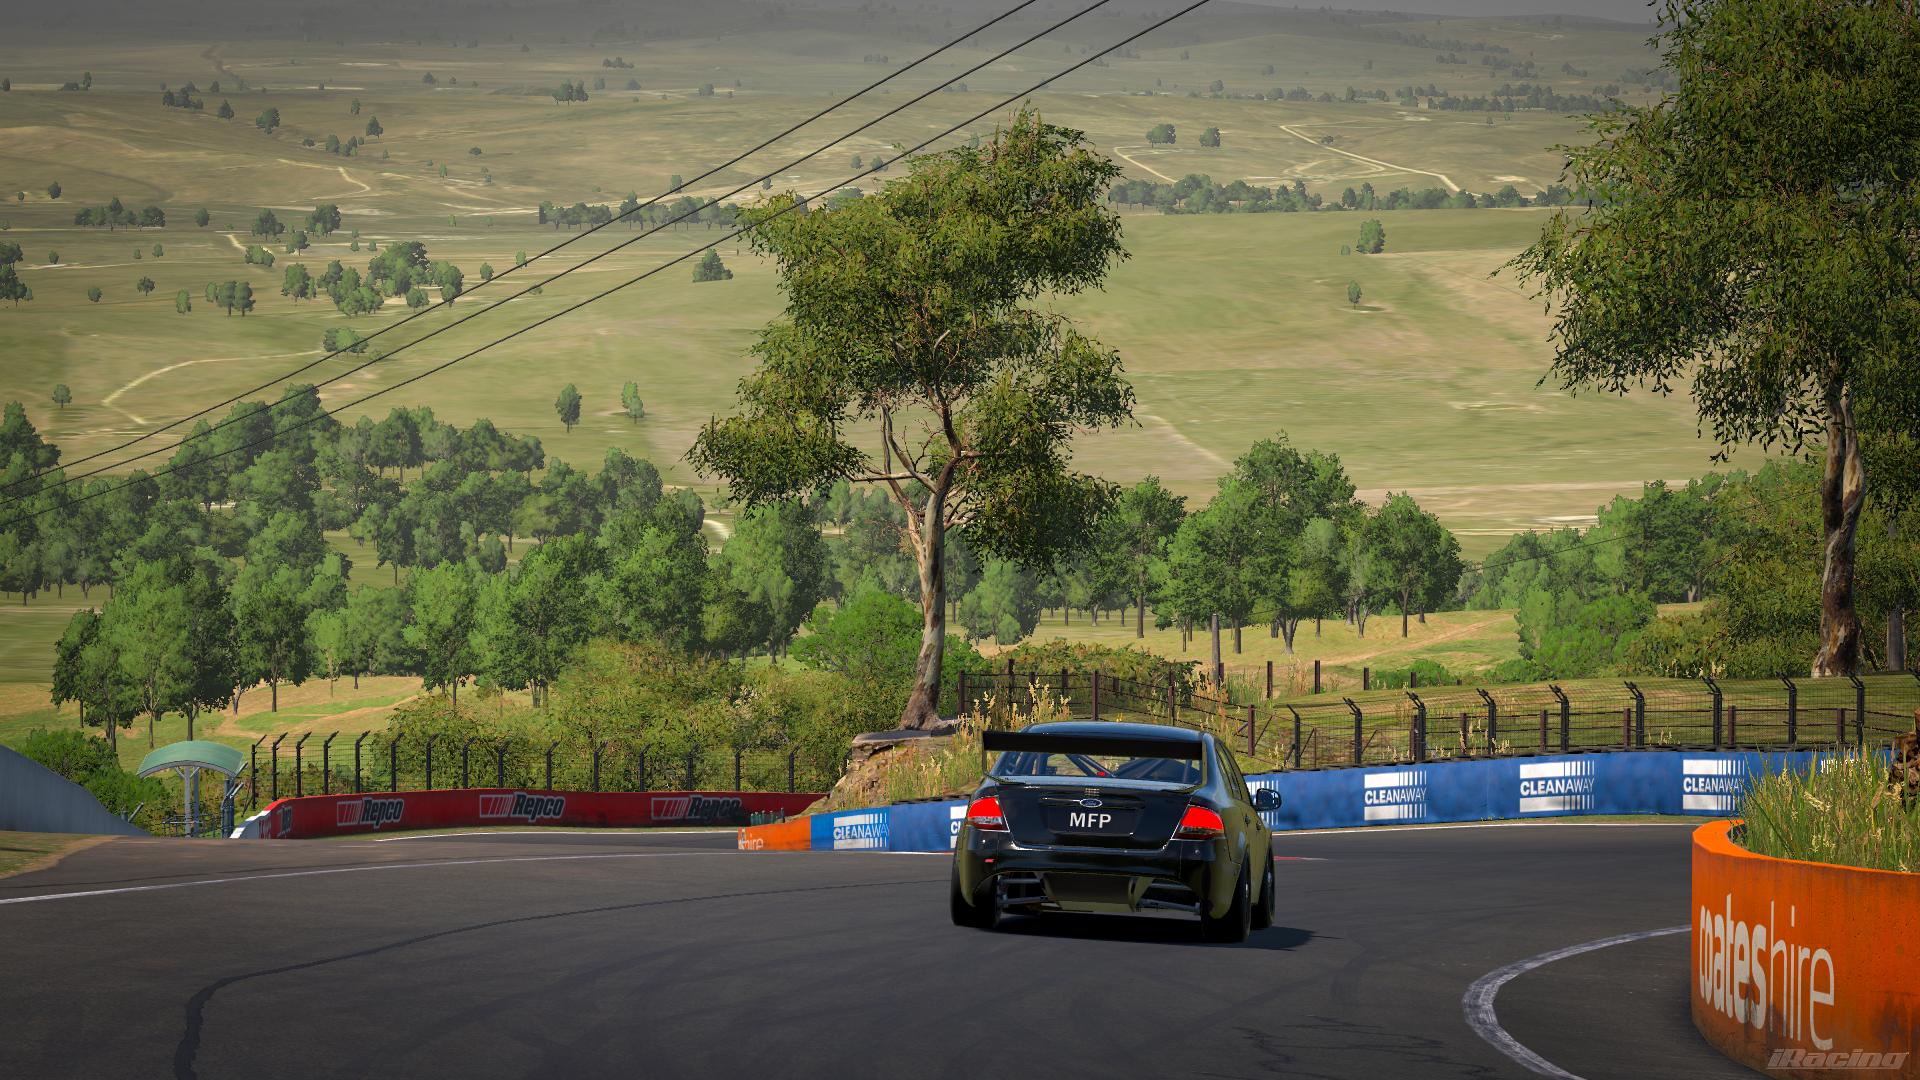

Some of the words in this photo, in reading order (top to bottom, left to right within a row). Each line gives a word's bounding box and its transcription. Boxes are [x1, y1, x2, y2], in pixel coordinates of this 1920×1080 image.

[1364, 787, 1427, 804] CLEANAWAY
[1519, 777, 1594, 796] CLEANAWAY
[360, 798, 404, 828] Repco
[511, 792, 565, 822] Repco
[1070, 812, 1112, 829] MFP
